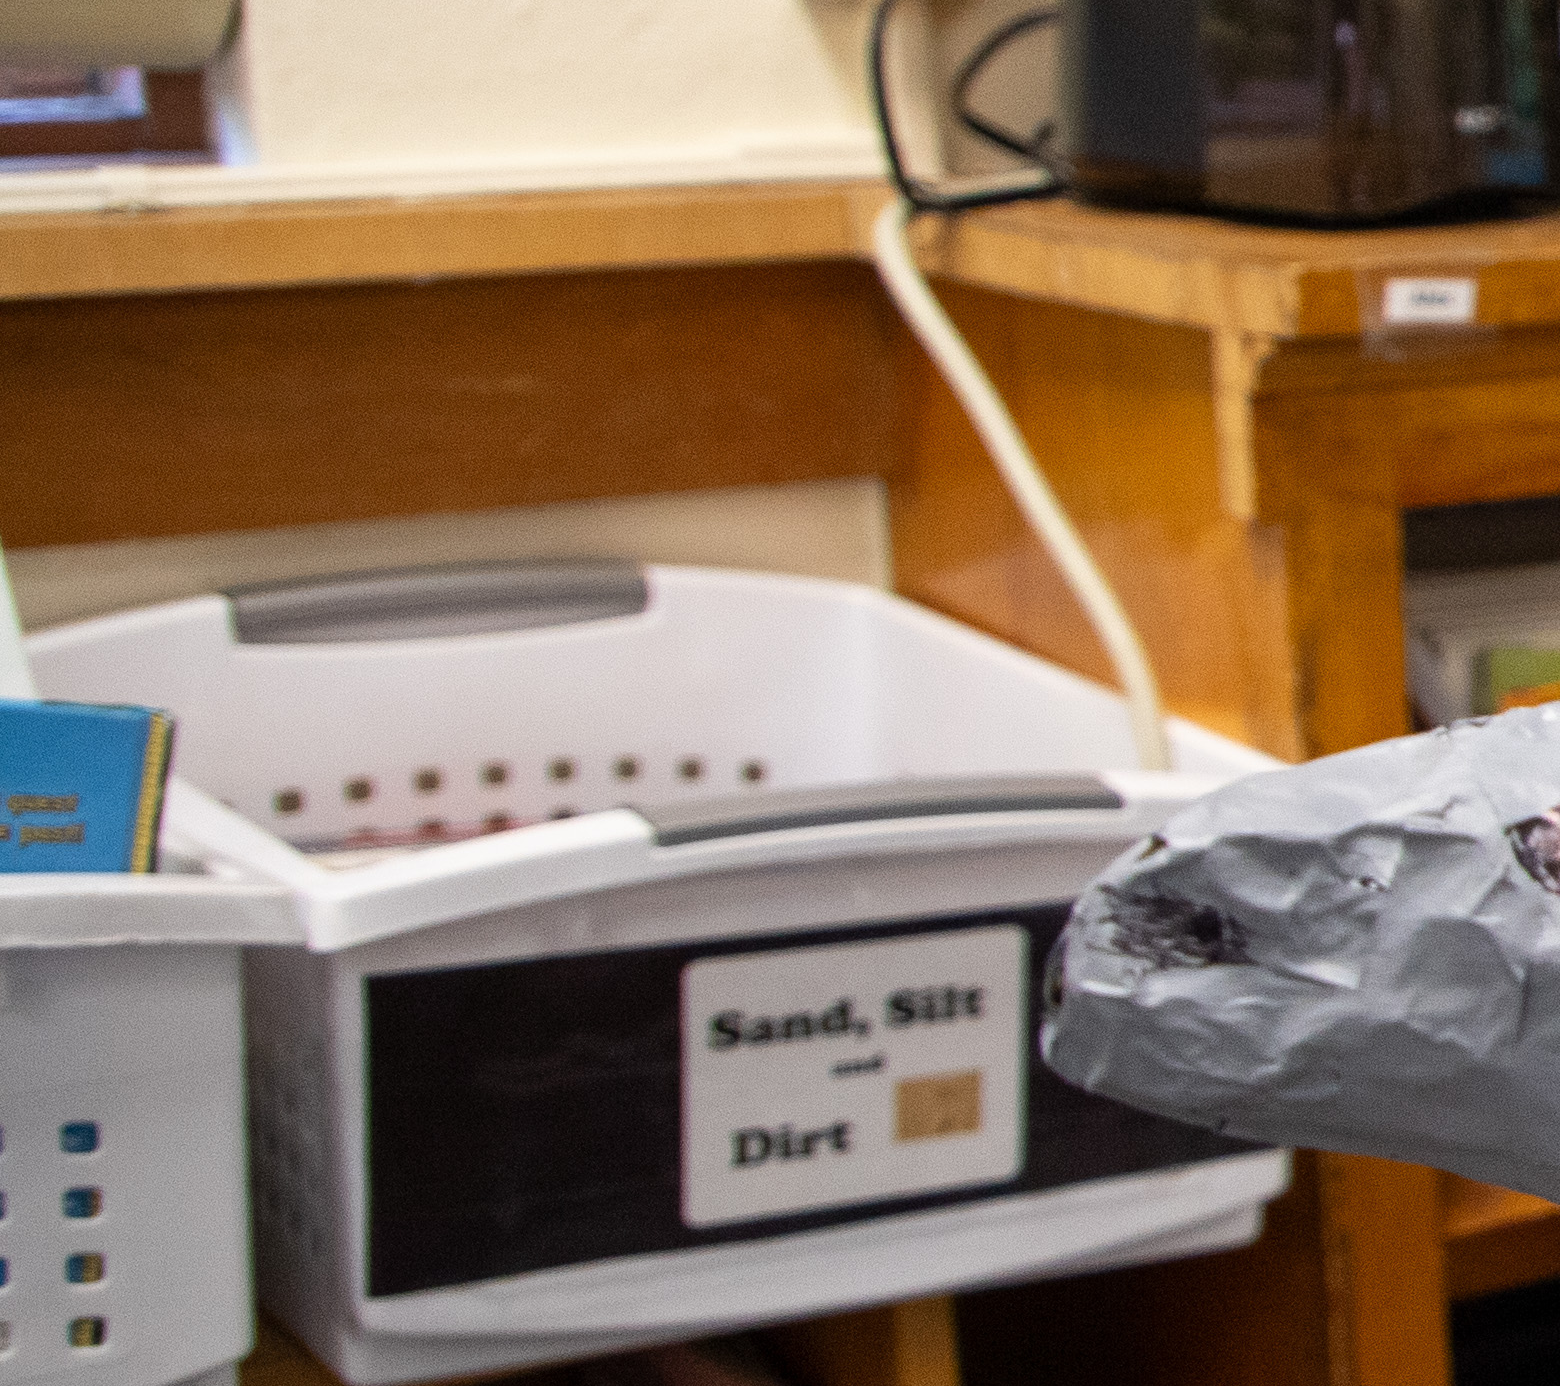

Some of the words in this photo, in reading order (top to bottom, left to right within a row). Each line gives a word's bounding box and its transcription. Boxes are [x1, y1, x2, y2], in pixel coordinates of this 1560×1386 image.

[706, 994, 872, 1052] Sand,
[884, 982, 987, 1027] Silt
[830, 1051, 887, 1078] and
[729, 1116, 854, 1171] Dirt
